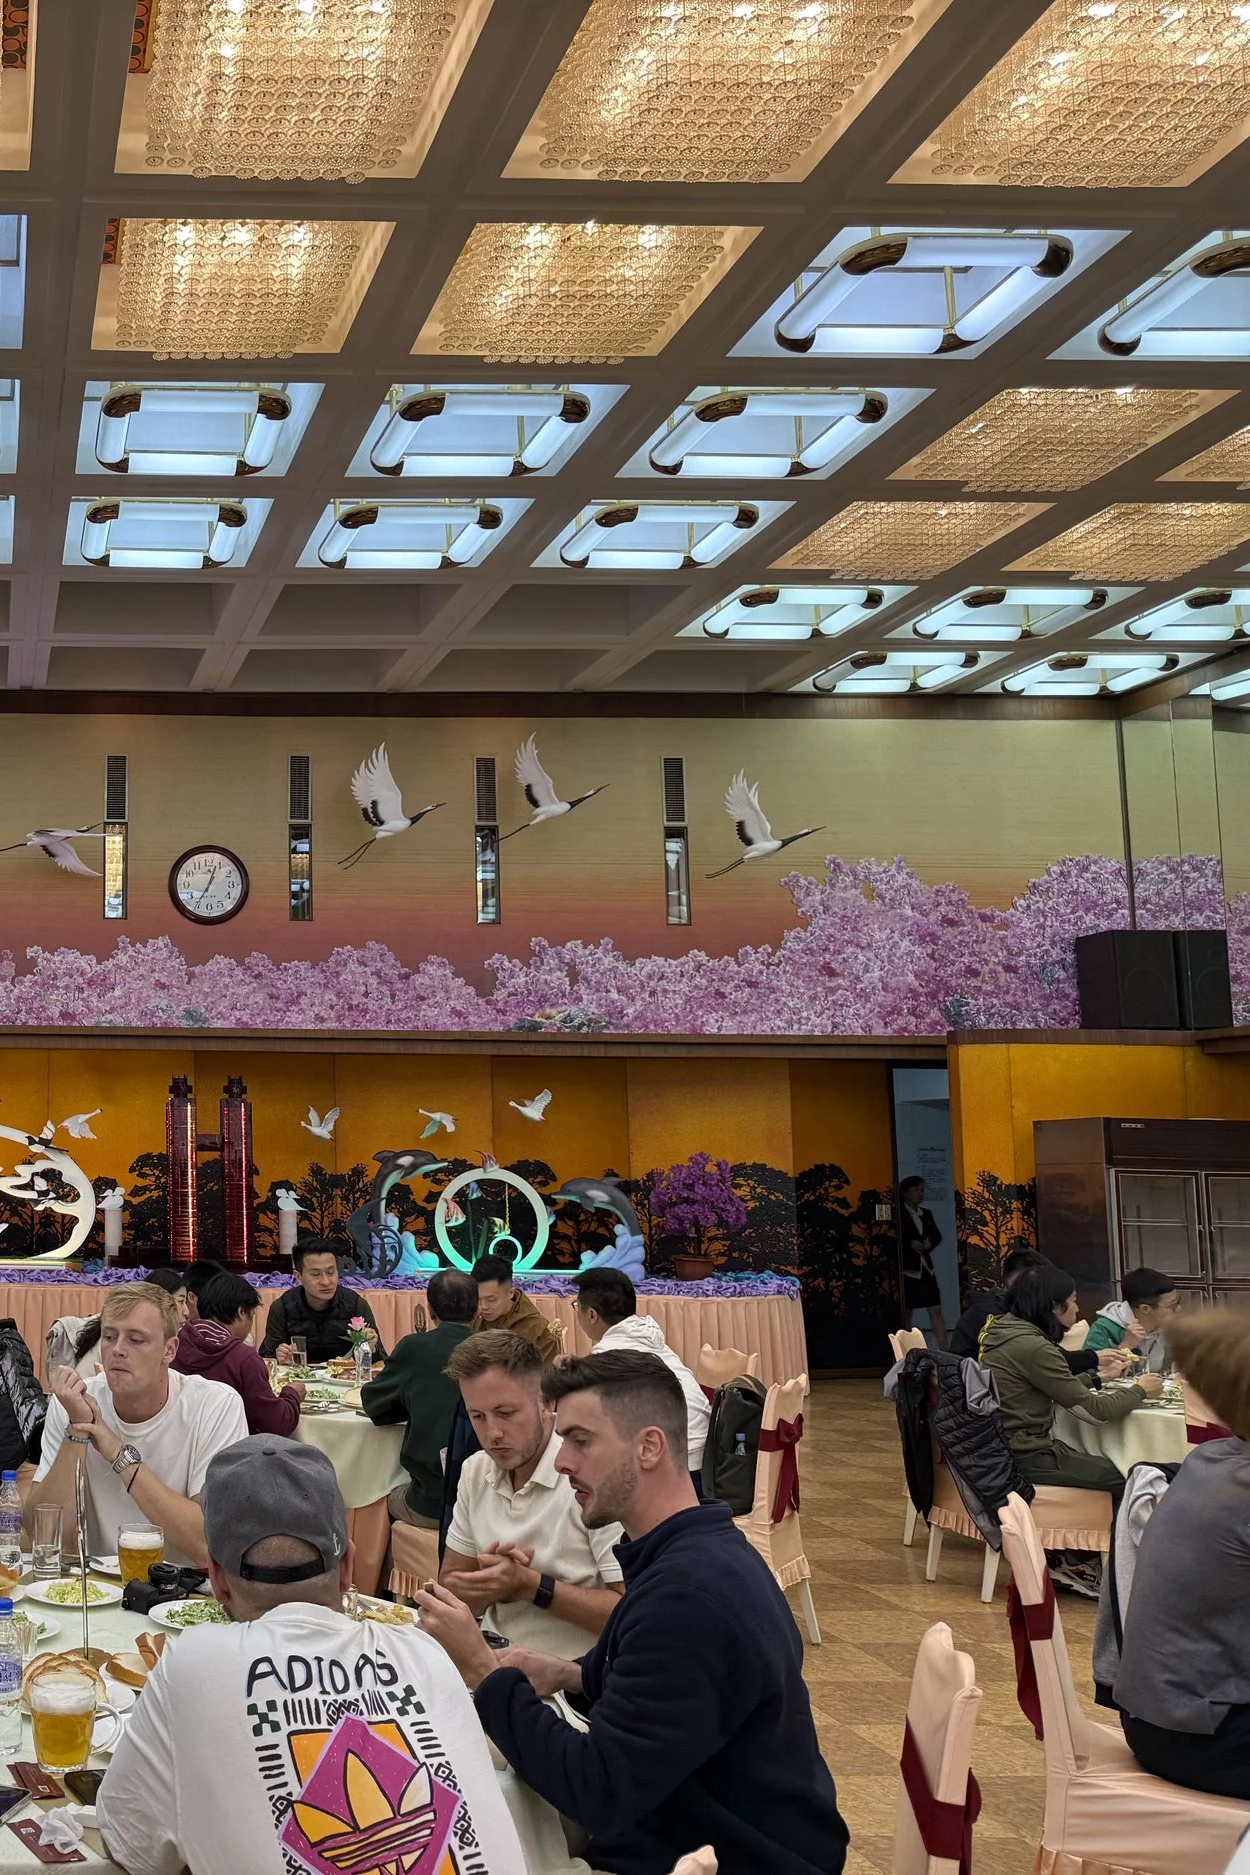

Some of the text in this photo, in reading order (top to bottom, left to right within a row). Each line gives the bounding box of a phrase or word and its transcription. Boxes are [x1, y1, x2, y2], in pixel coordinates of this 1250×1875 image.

[193, 861, 201, 870] 11
[204, 859, 214, 867] 12
[185, 870, 194, 878] 10
[225, 870, 232, 878] 2
[183, 881, 190, 889] 9
[227, 880, 235, 889] 3
[224, 891, 231, 899] 4
[206, 903, 213, 911] 6
[217, 900, 224, 908] 5
